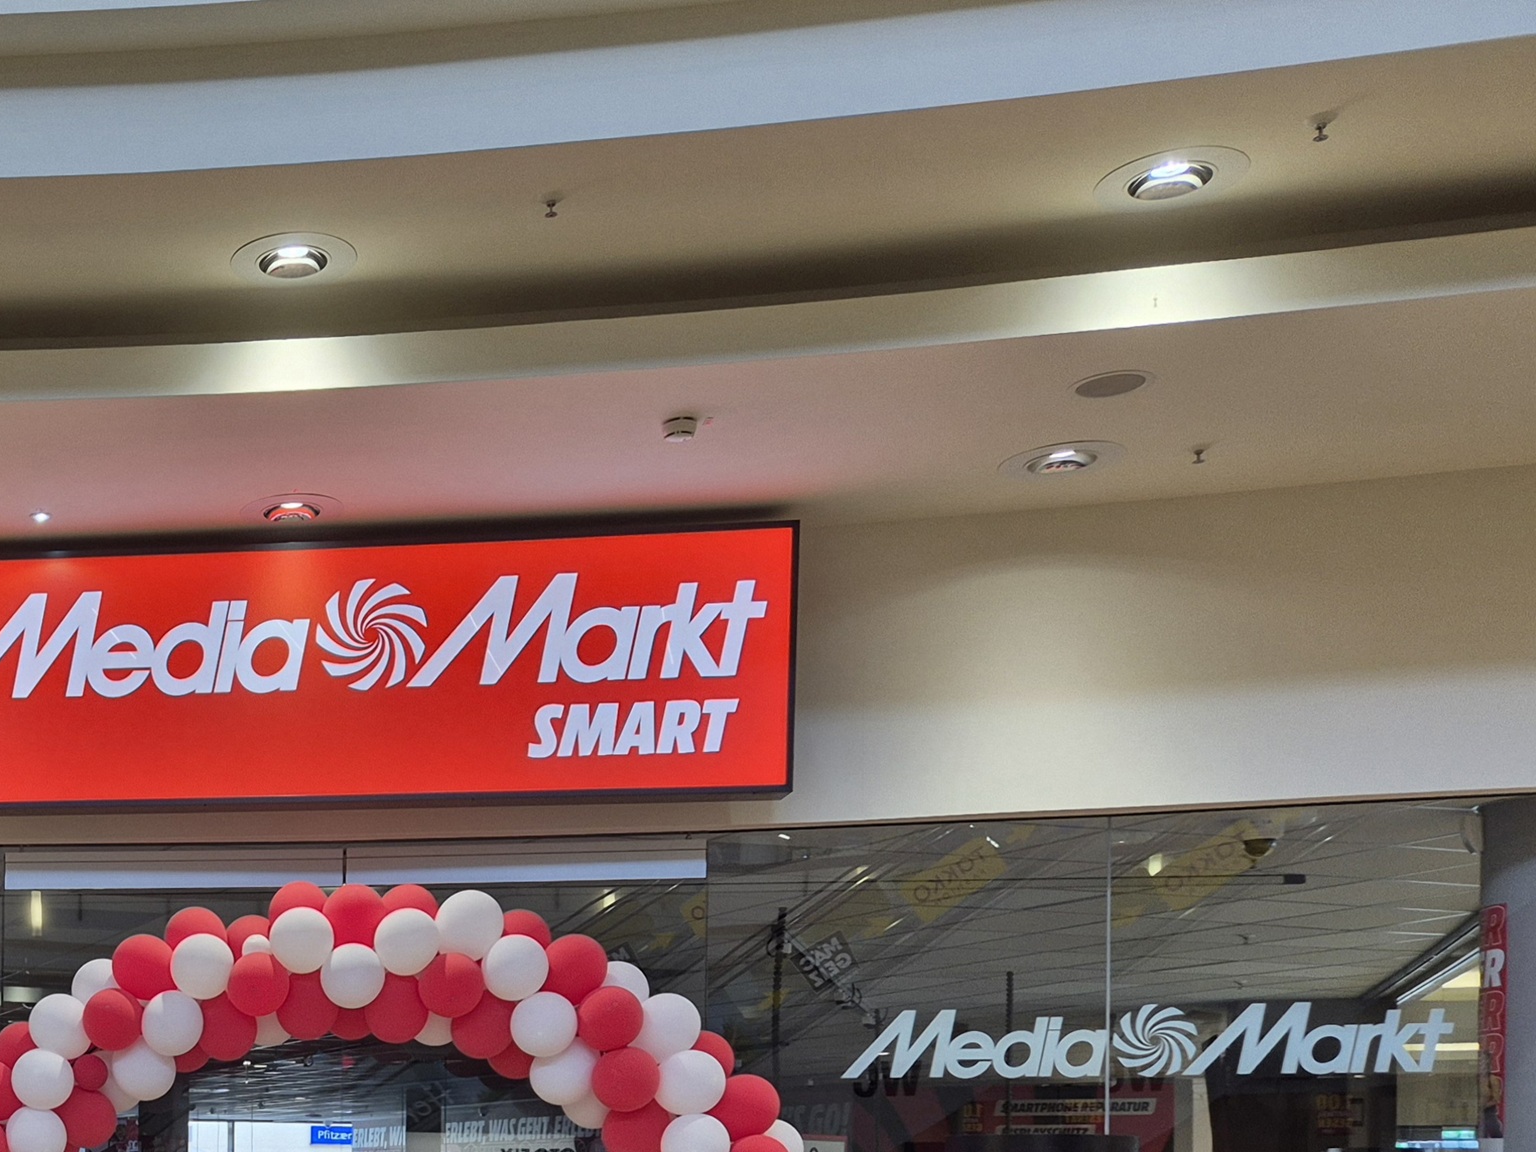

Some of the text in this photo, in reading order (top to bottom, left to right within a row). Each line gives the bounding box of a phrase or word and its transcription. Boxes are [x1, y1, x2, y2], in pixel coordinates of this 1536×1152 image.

[407, 572, 767, 688] Markt
[527, 698, 738, 758] SMART
[1081, 1100, 1150, 1113] REPRATUR
[489, 1118, 517, 1142] WAS
